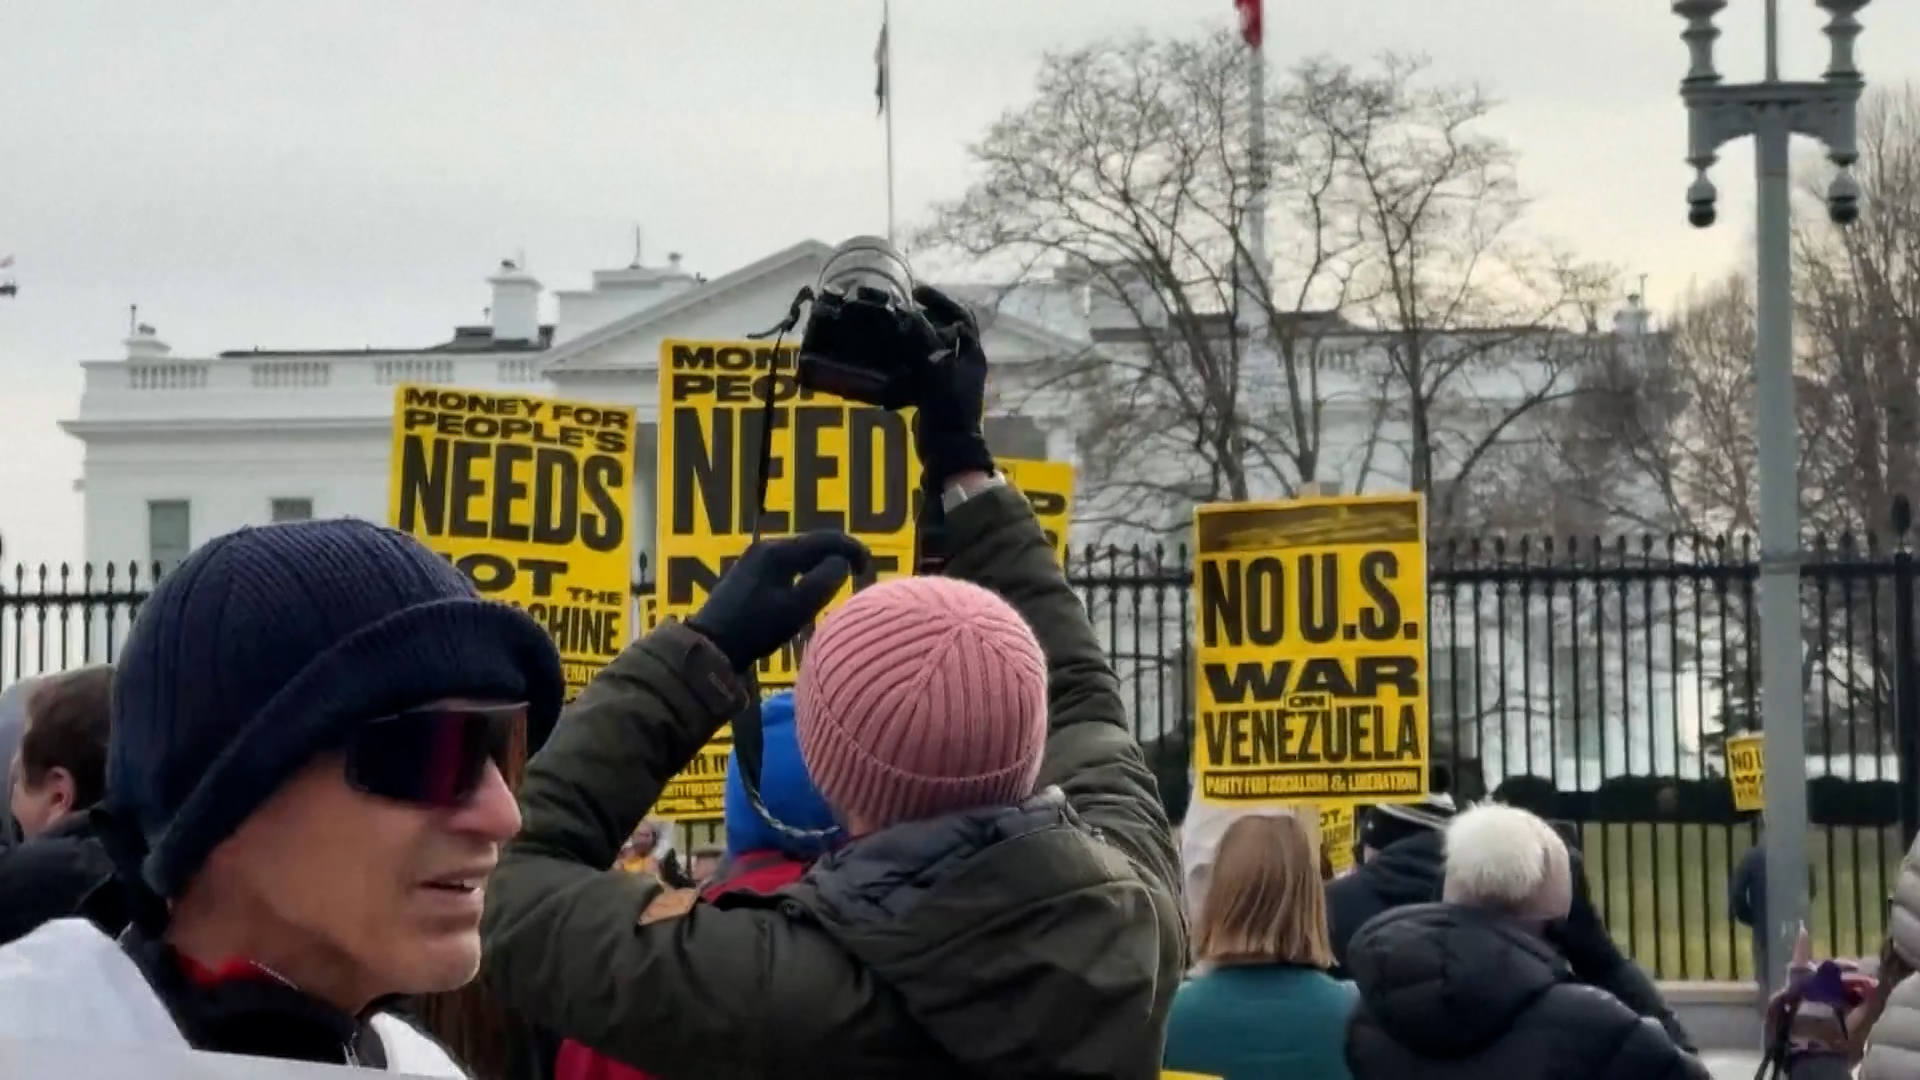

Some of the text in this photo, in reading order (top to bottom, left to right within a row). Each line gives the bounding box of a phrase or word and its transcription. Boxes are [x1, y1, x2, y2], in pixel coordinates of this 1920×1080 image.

[404, 387, 629, 431] MONEY FOR
[404, 408, 627, 453] PEOPLE'S
[399, 434, 624, 552] NEEDS
[672, 407, 923, 535] NEED
[439, 552, 623, 605] OT THE
[1202, 550, 1418, 648] NO U.S.
[1204, 656, 1419, 704] WAR
[1289, 694, 1326, 709] ON
[1203, 703, 1422, 766] VENEZUELA
[1206, 771, 1419, 795] PARTY FOR SOCIALISM & LIBERATION
